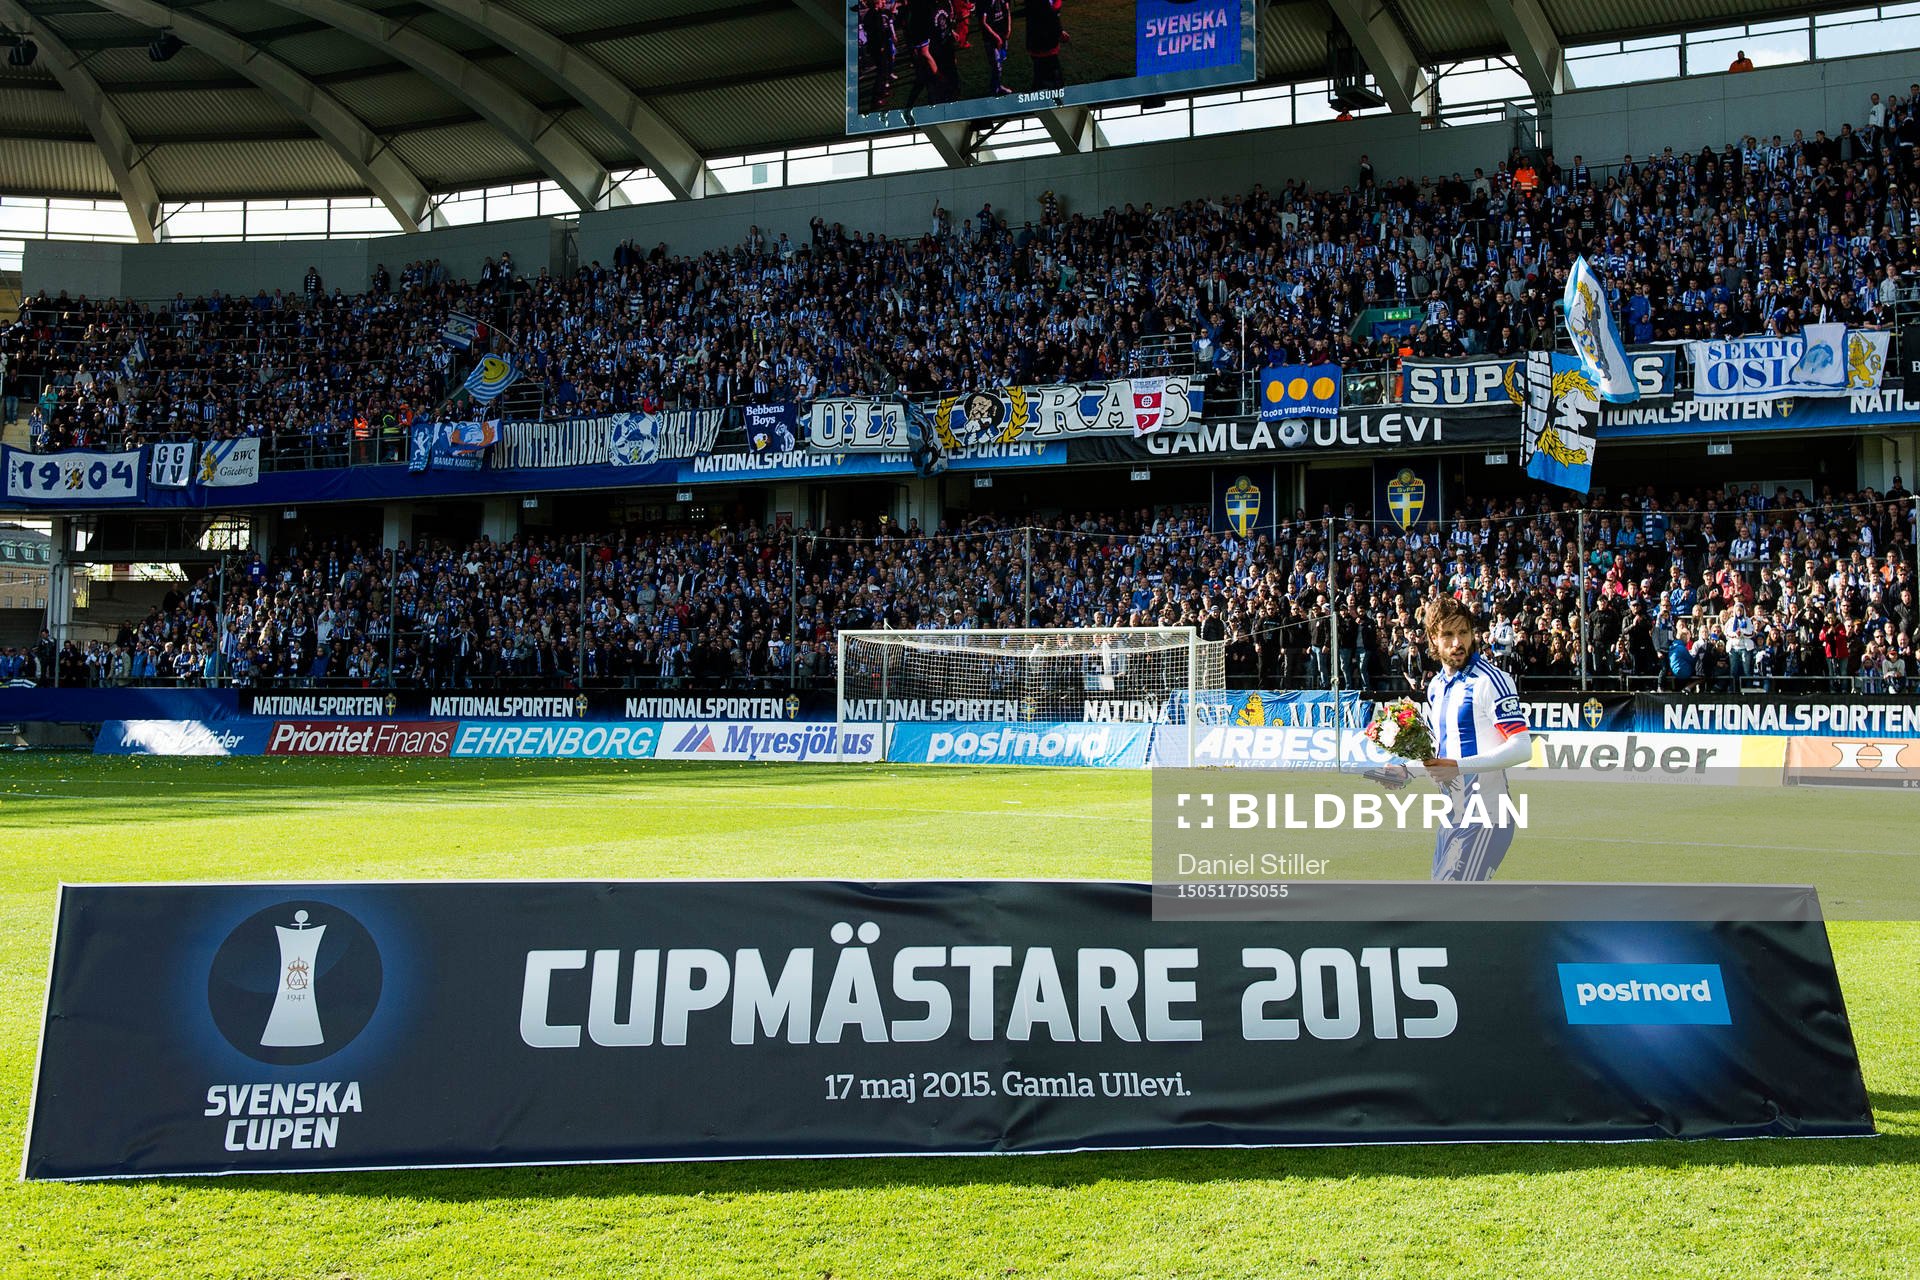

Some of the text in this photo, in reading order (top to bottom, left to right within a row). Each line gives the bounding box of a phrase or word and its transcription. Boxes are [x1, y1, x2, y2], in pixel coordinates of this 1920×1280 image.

[1145, 9, 1228, 39] SVENSKA
[1157, 30, 1216, 57] CUPEN
[1018, 87, 1065, 104] SAMSUNG
[746, 404, 785, 416] Bebbens
[752, 415, 776, 428] Boys
[1262, 409, 1283, 418] GOOD
[1147, 413, 1442, 455] GAMLA ULLEVI
[232, 448, 256, 461] BWC
[693, 451, 831, 473] NATIONALSPORTEN
[219, 466, 254, 479] Göteborg
[253, 696, 384, 717] NATIONALSPORTEN
[429, 696, 574, 718] NATIONALSPORTEN
[625, 697, 784, 720] NATIONALSPORTEN
[842, 699, 1018, 721] NATIONALSPORTEN
[1664, 704, 1920, 732] NATIONALSPORTEN
[271, 724, 372, 753] Prioritet
[377, 730, 457, 754] Finans
[455, 727, 653, 756] EHRENBORG
[723, 725, 874, 760] Myresjöhus
[926, 727, 1110, 763] postnord
[1545, 736, 1718, 774] weber
[519, 921, 1459, 1049] CUPMÄSTARE 2015
[1576, 979, 1712, 1008] postnord
[204, 1081, 363, 1117] SVENSKA
[824, 1071, 1192, 1104] 17 maj 2015. Gamla Ullevi.
[224, 1117, 340, 1152] CUPEN
